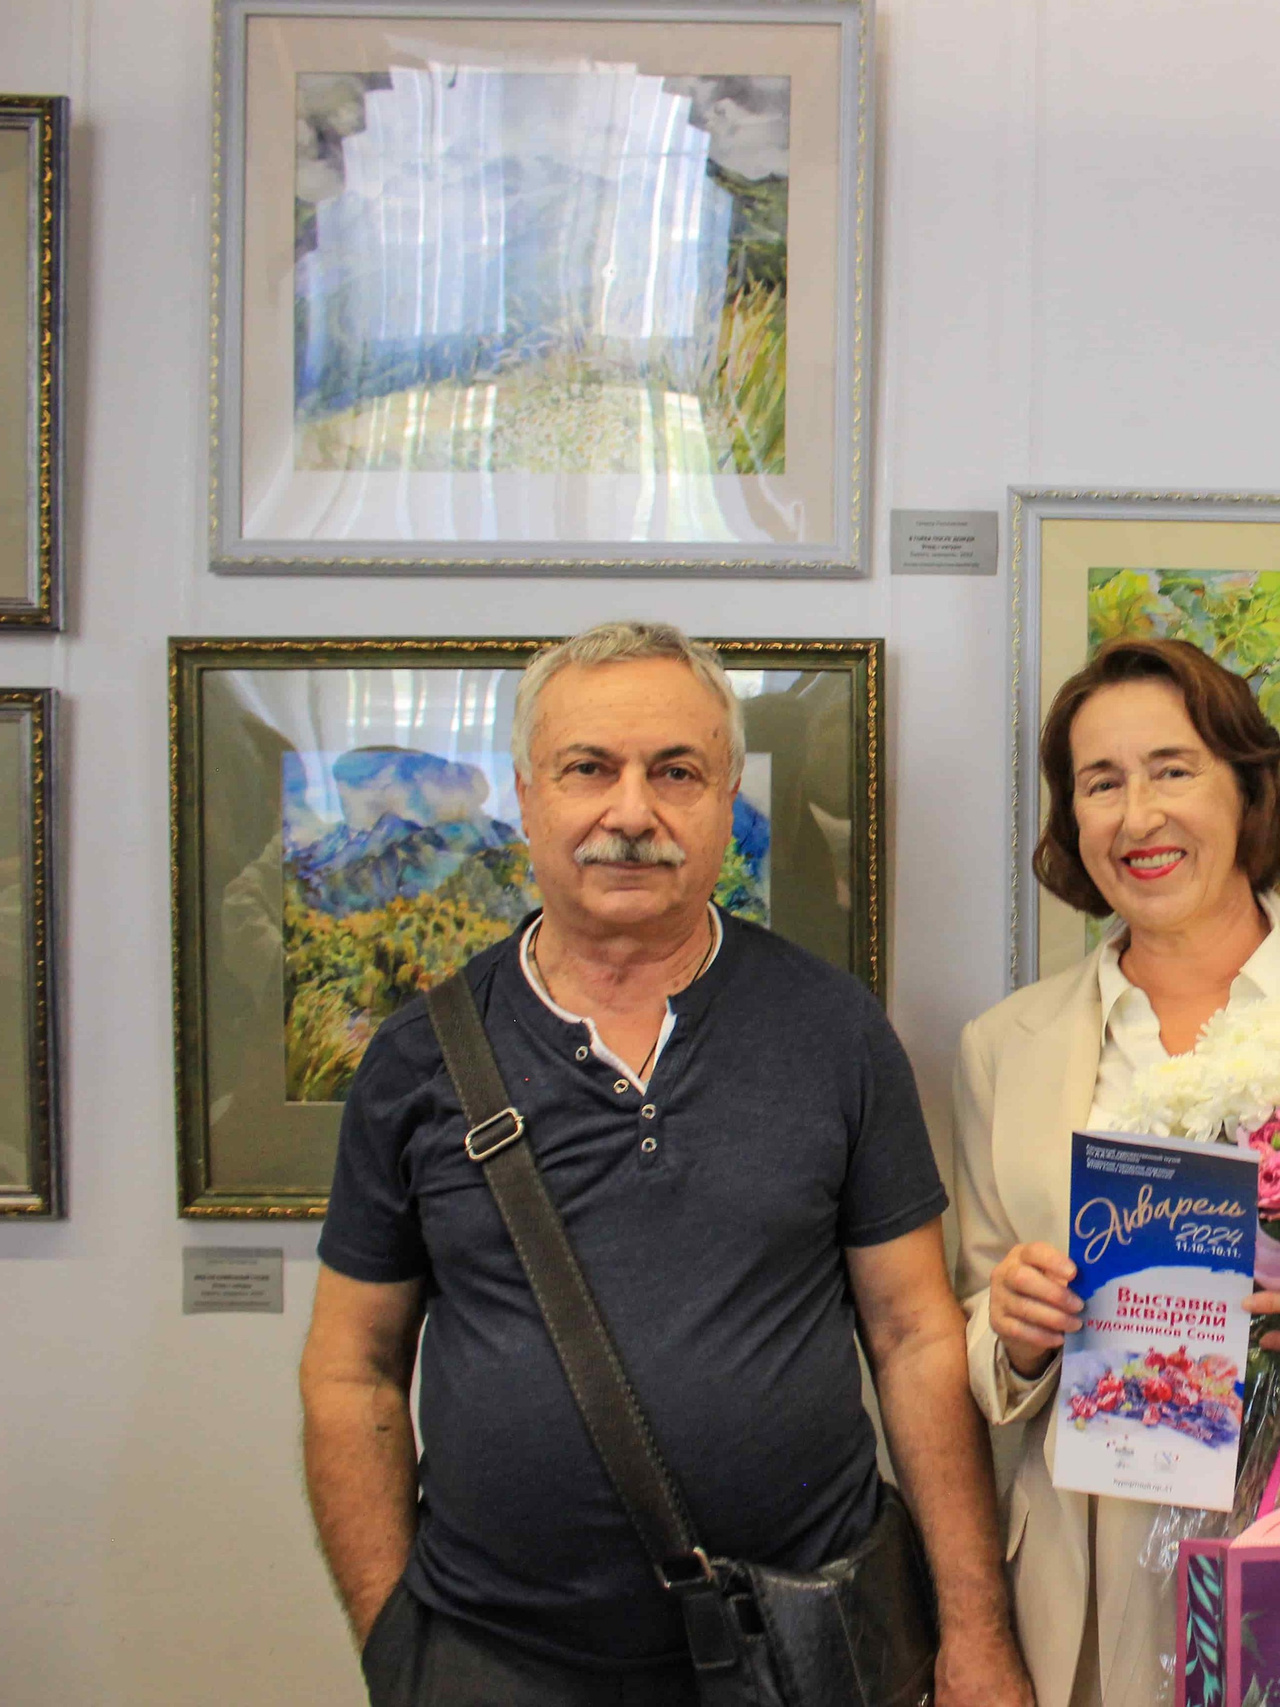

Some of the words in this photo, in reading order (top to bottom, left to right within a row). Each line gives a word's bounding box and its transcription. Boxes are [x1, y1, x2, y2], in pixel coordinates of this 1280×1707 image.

[1074, 1183, 1247, 1265] Акварель
[1174, 1222, 1244, 1248] 2024
[1117, 1286, 1228, 1314] Выставка
[1116, 1305, 1227, 1328] акварели
[1086, 1317, 1182, 1337] художников
[1187, 1327, 1226, 1343] Сочи
